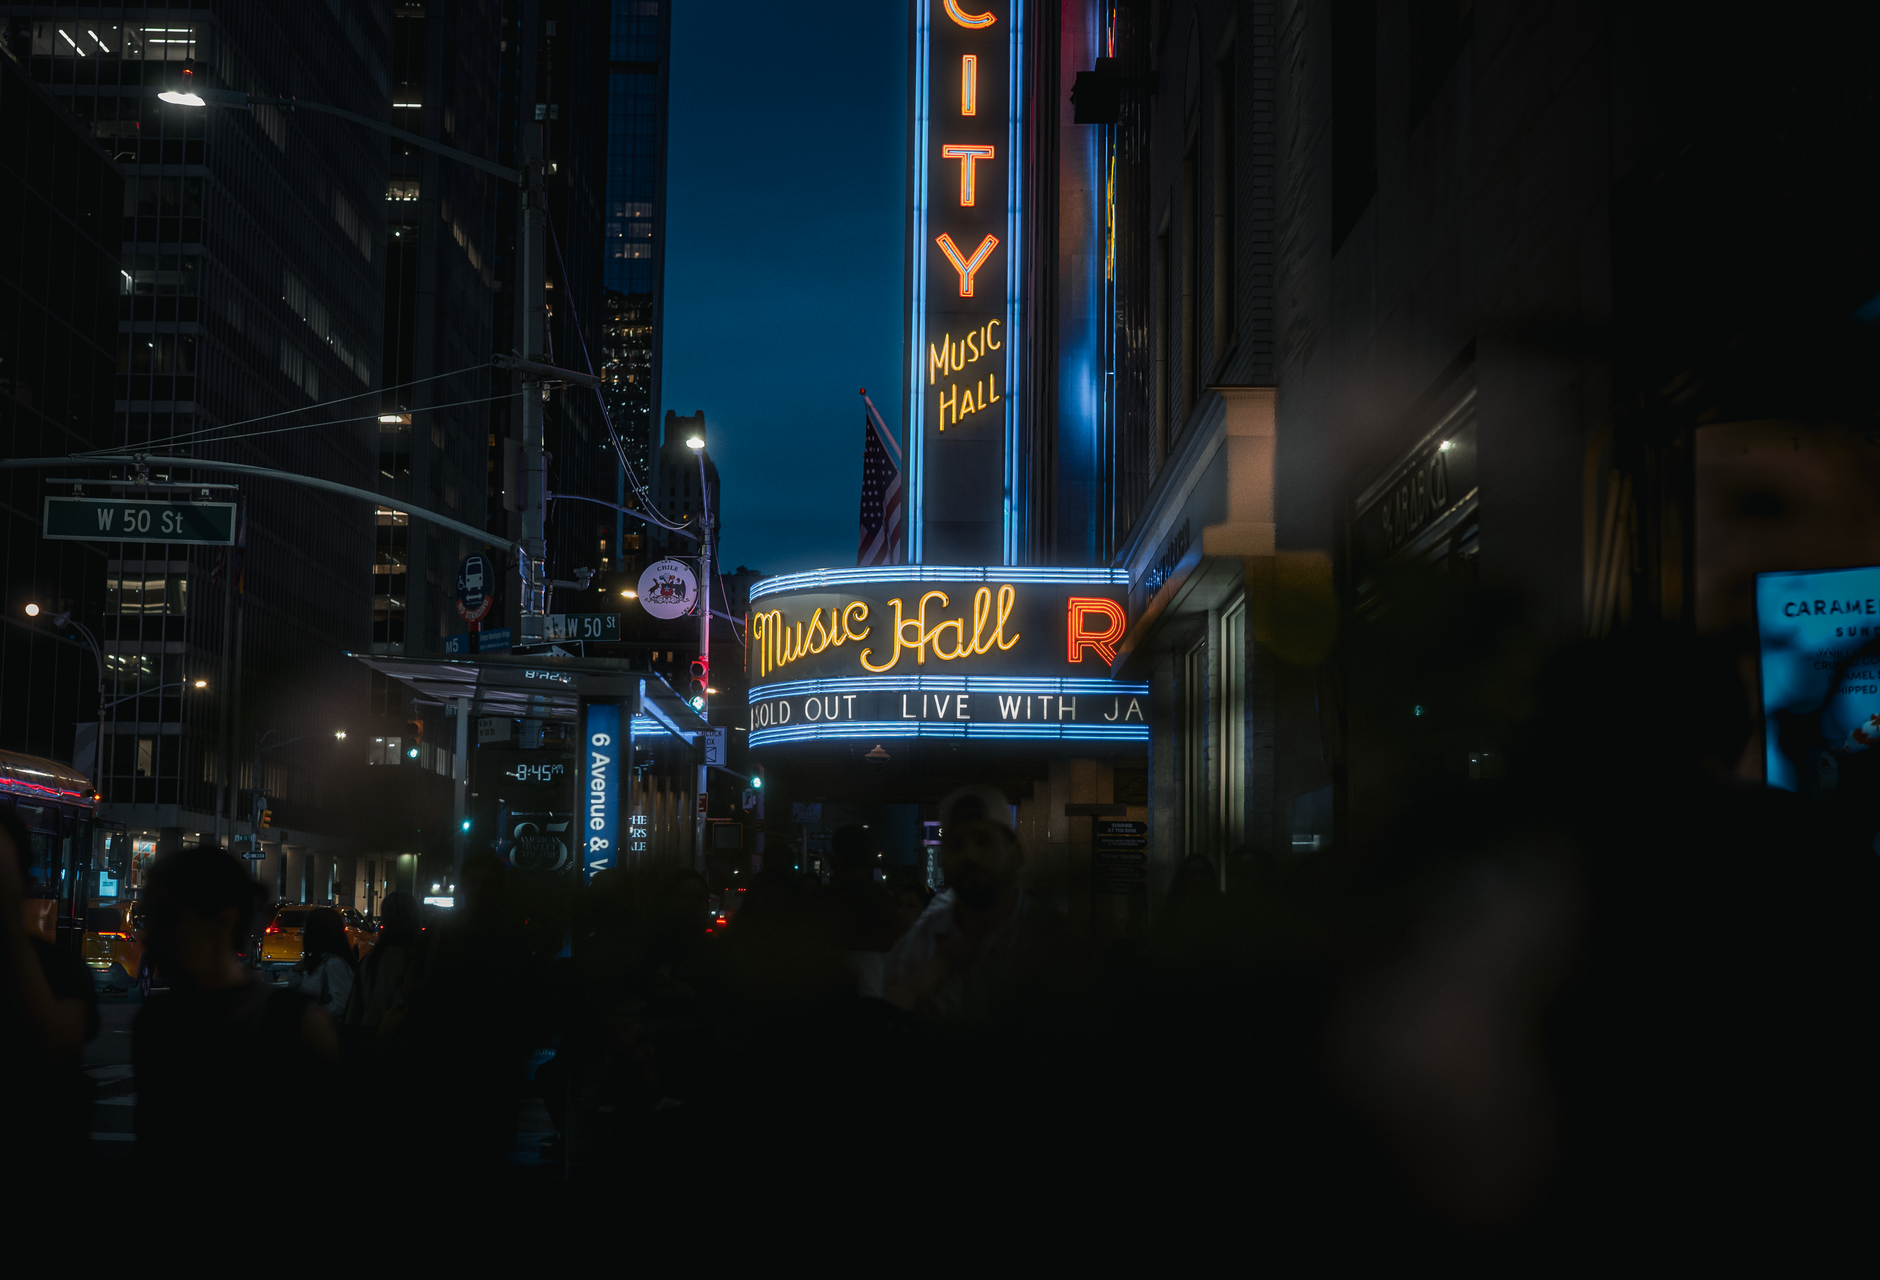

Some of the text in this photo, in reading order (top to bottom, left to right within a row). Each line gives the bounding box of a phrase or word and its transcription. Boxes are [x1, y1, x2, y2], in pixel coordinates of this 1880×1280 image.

[97, 508, 184, 534] W 50 St
[656, 564, 679, 573] CHILE
[457, 598, 489, 620] NO STANDING
[1784, 599, 1880, 618] CARAME
[567, 616, 616, 638] W 50 St
[753, 600, 870, 678] Music
[860, 584, 1021, 673] Hall
[445, 637, 459, 654] M5
[1837, 684, 1878, 695] HIPPED
[755, 694, 1144, 728] SOLD OUT LIVE WITH JA
[591, 733, 611, 747] 6
[589, 752, 611, 831] Avenue
[589, 836, 609, 853] &
